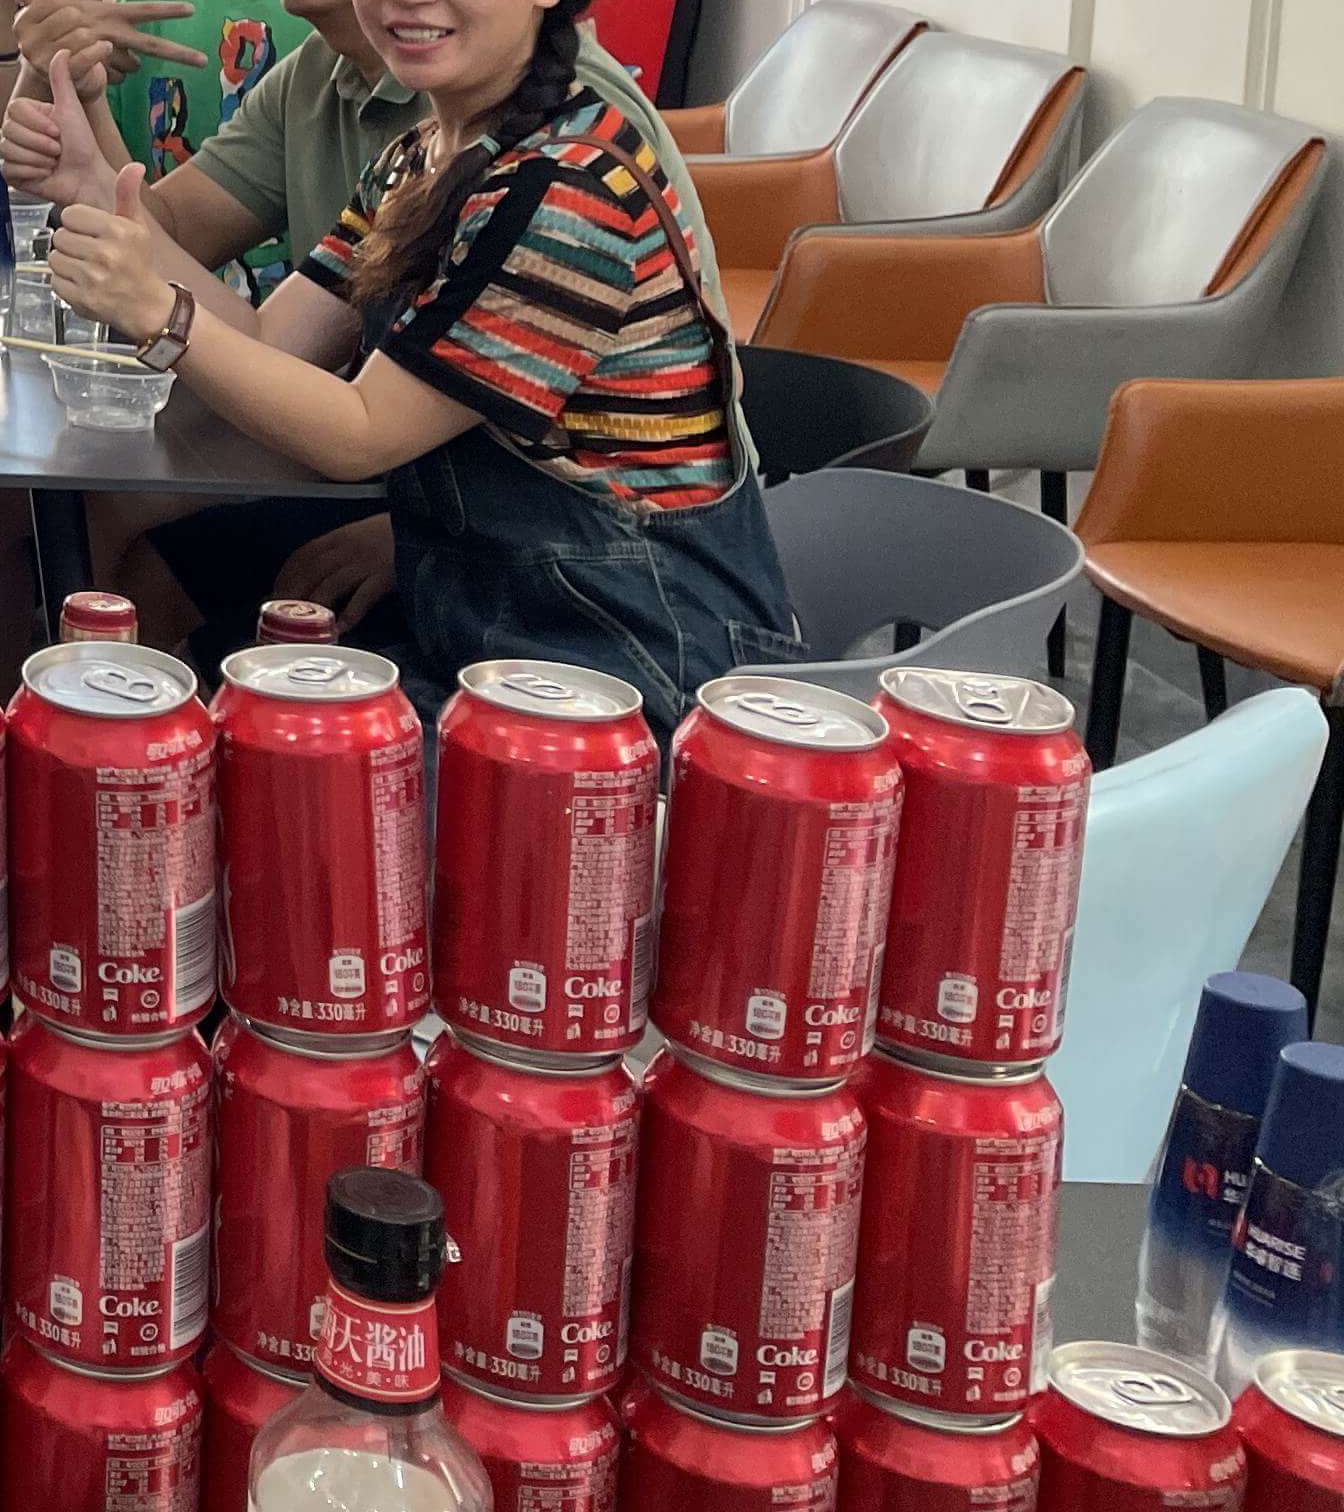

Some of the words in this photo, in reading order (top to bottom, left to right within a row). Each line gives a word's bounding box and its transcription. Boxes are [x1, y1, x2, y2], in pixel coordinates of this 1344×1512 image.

[380, 948, 424, 975] Coke
[97, 962, 161, 985] Coke
[563, 976, 621, 999] Coke
[995, 986, 1051, 1009] Coke
[804, 1003, 859, 1027] Coke
[98, 1295, 160, 1318] Coke
[560, 1320, 614, 1344] Coke
[756, 1344, 818, 1368] Coke
[963, 1339, 1024, 1362] Coke
